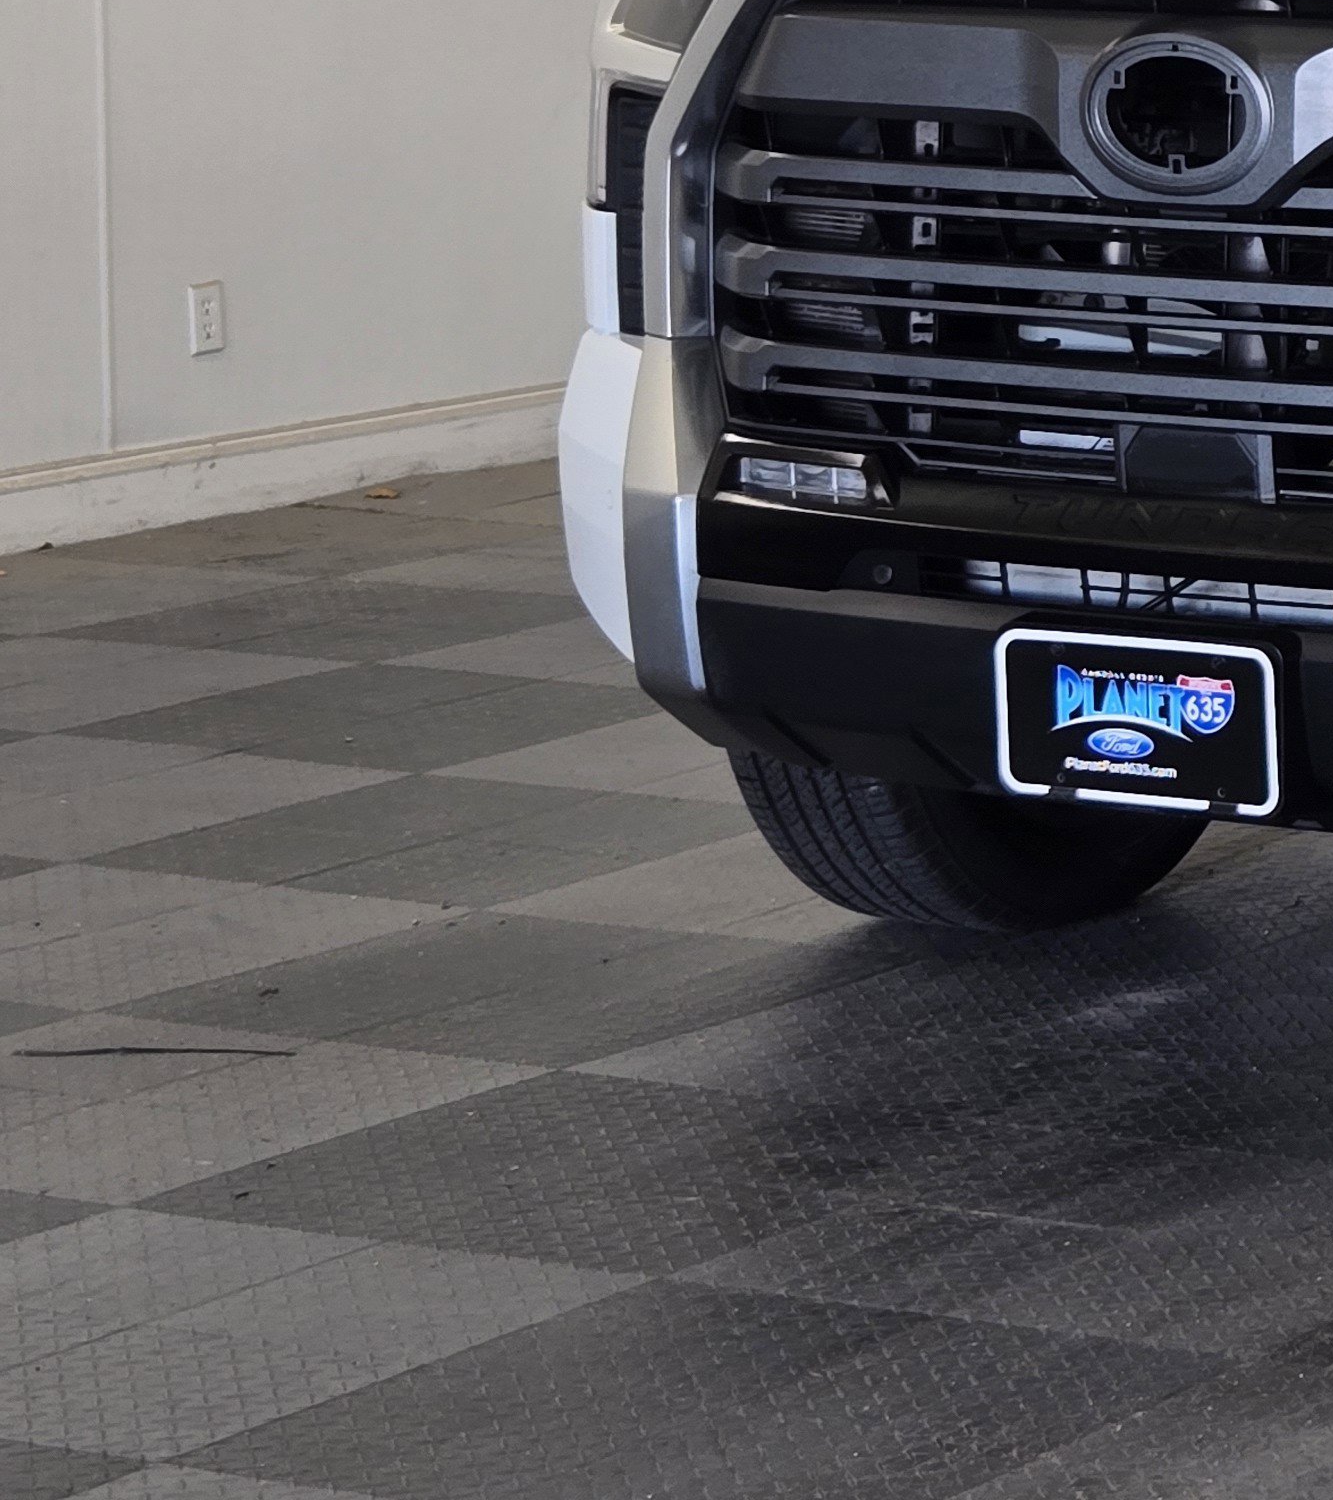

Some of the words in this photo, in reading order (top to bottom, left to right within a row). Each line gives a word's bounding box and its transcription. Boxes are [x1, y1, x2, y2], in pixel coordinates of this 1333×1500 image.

[1057, 665, 1185, 732] PLANET
[1186, 695, 1226, 724] 635
[1101, 735, 1143, 755] Ford
